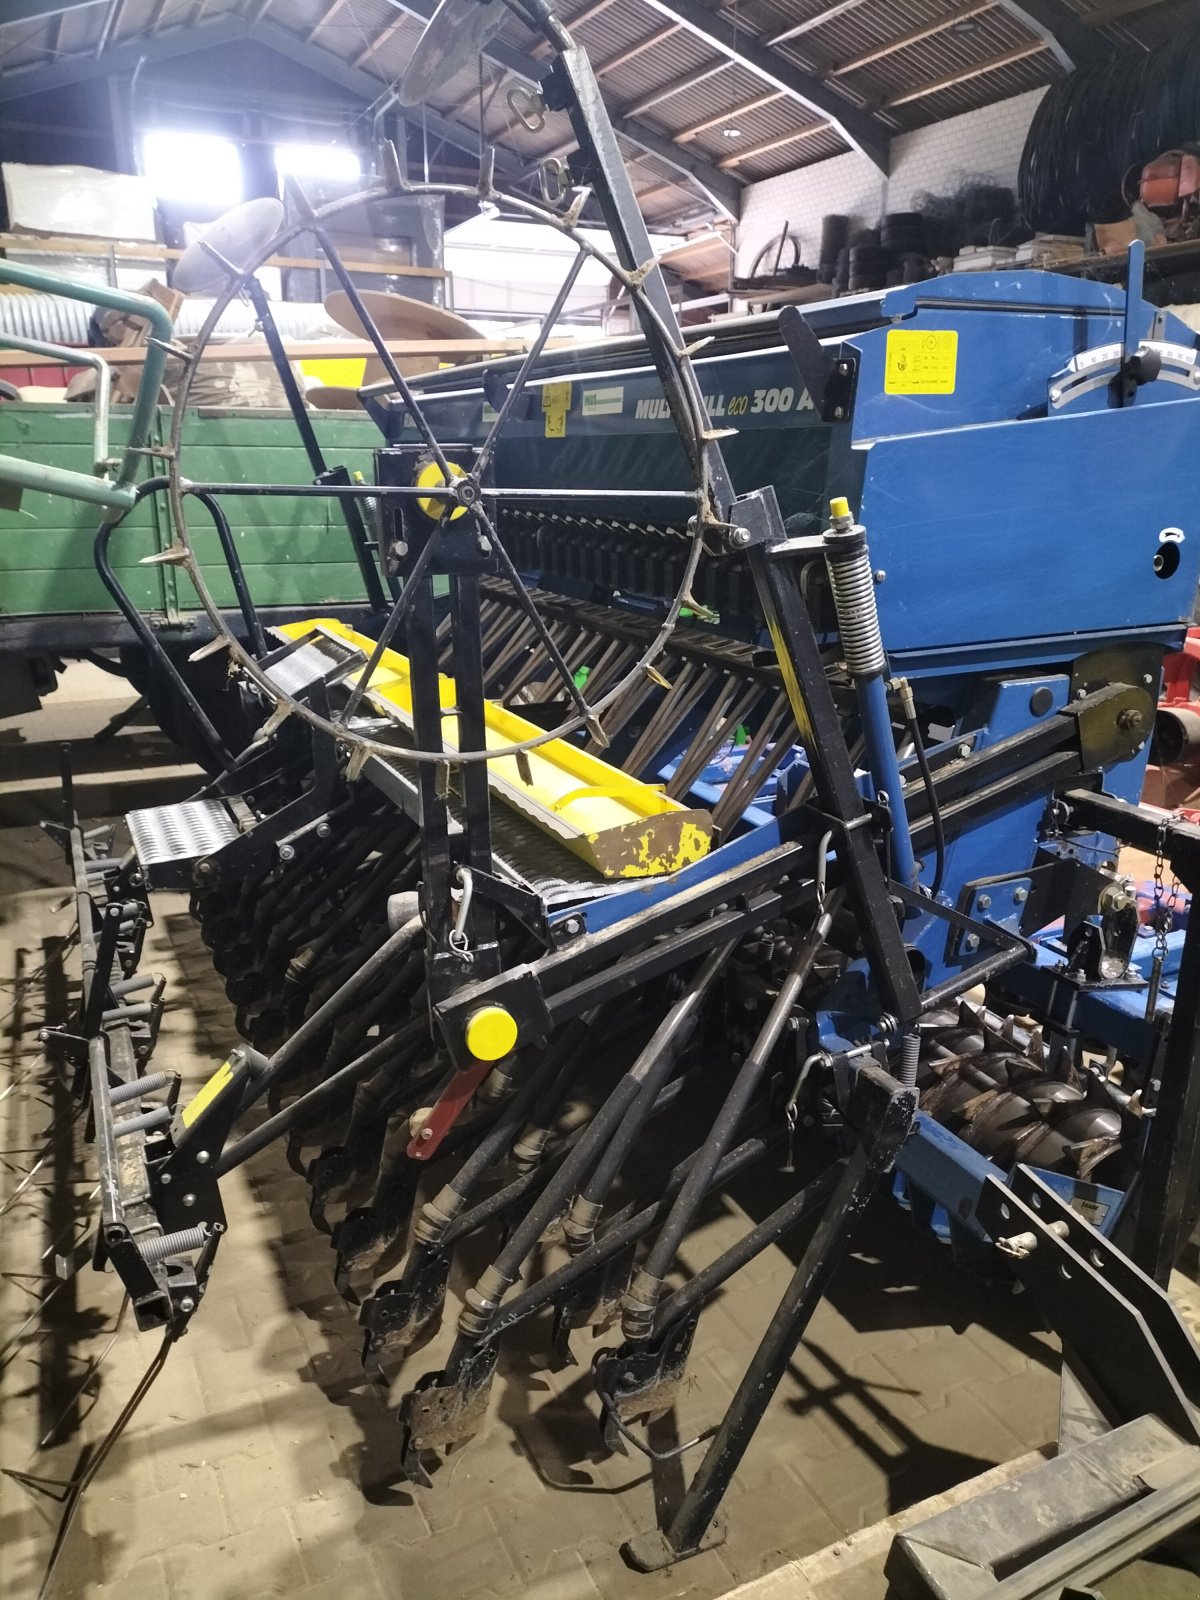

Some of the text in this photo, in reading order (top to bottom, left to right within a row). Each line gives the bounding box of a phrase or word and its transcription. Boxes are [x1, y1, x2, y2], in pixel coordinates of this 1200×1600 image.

[728, 394, 748, 416] eco
[751, 387, 794, 414] 300
[796, 387, 814, 411] A
